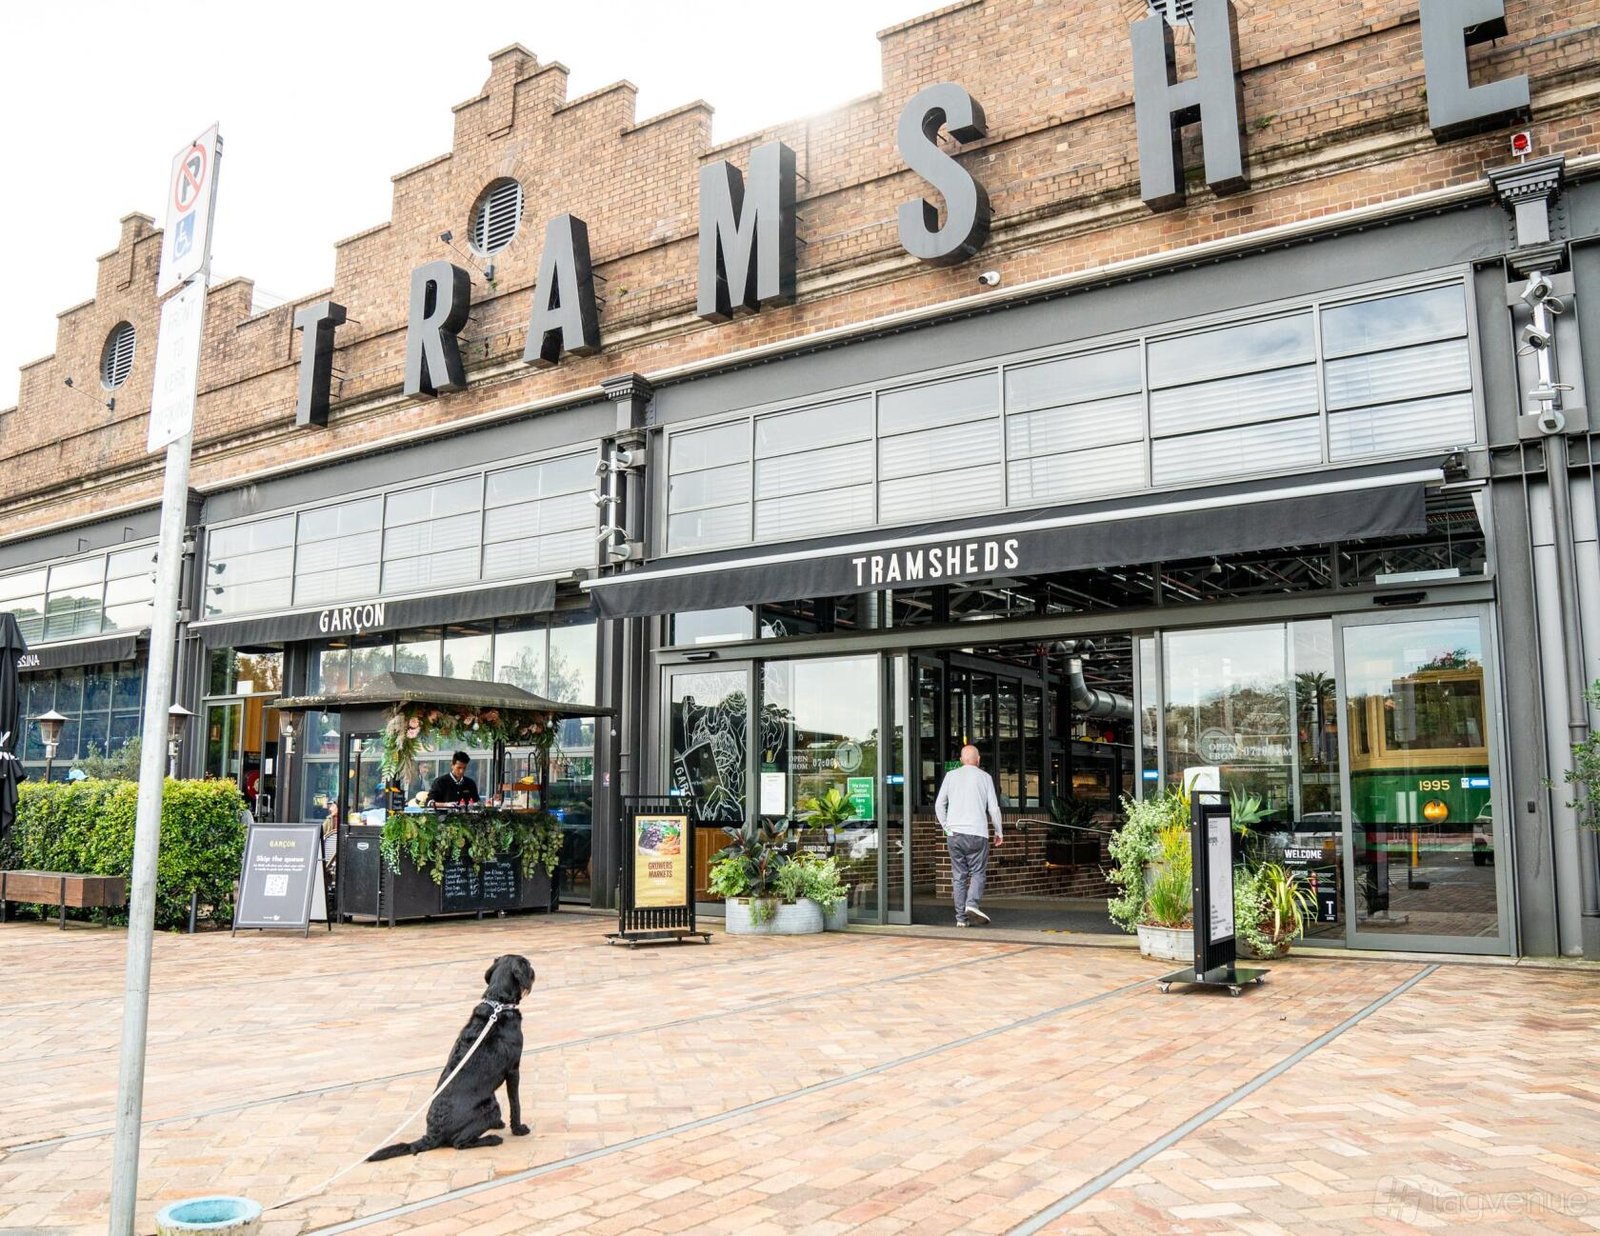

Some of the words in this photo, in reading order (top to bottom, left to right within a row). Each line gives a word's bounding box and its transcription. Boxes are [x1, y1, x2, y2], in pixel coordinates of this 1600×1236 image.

[852, 539, 1019, 586] TRAMSHEDS
[319, 603, 385, 634] GARÇON
[1419, 779, 1451, 791] 1995
[1284, 849, 1323, 859] WELCOME
[648, 861, 673, 870] GROWERS
[648, 870, 673, 878] MARKETS
